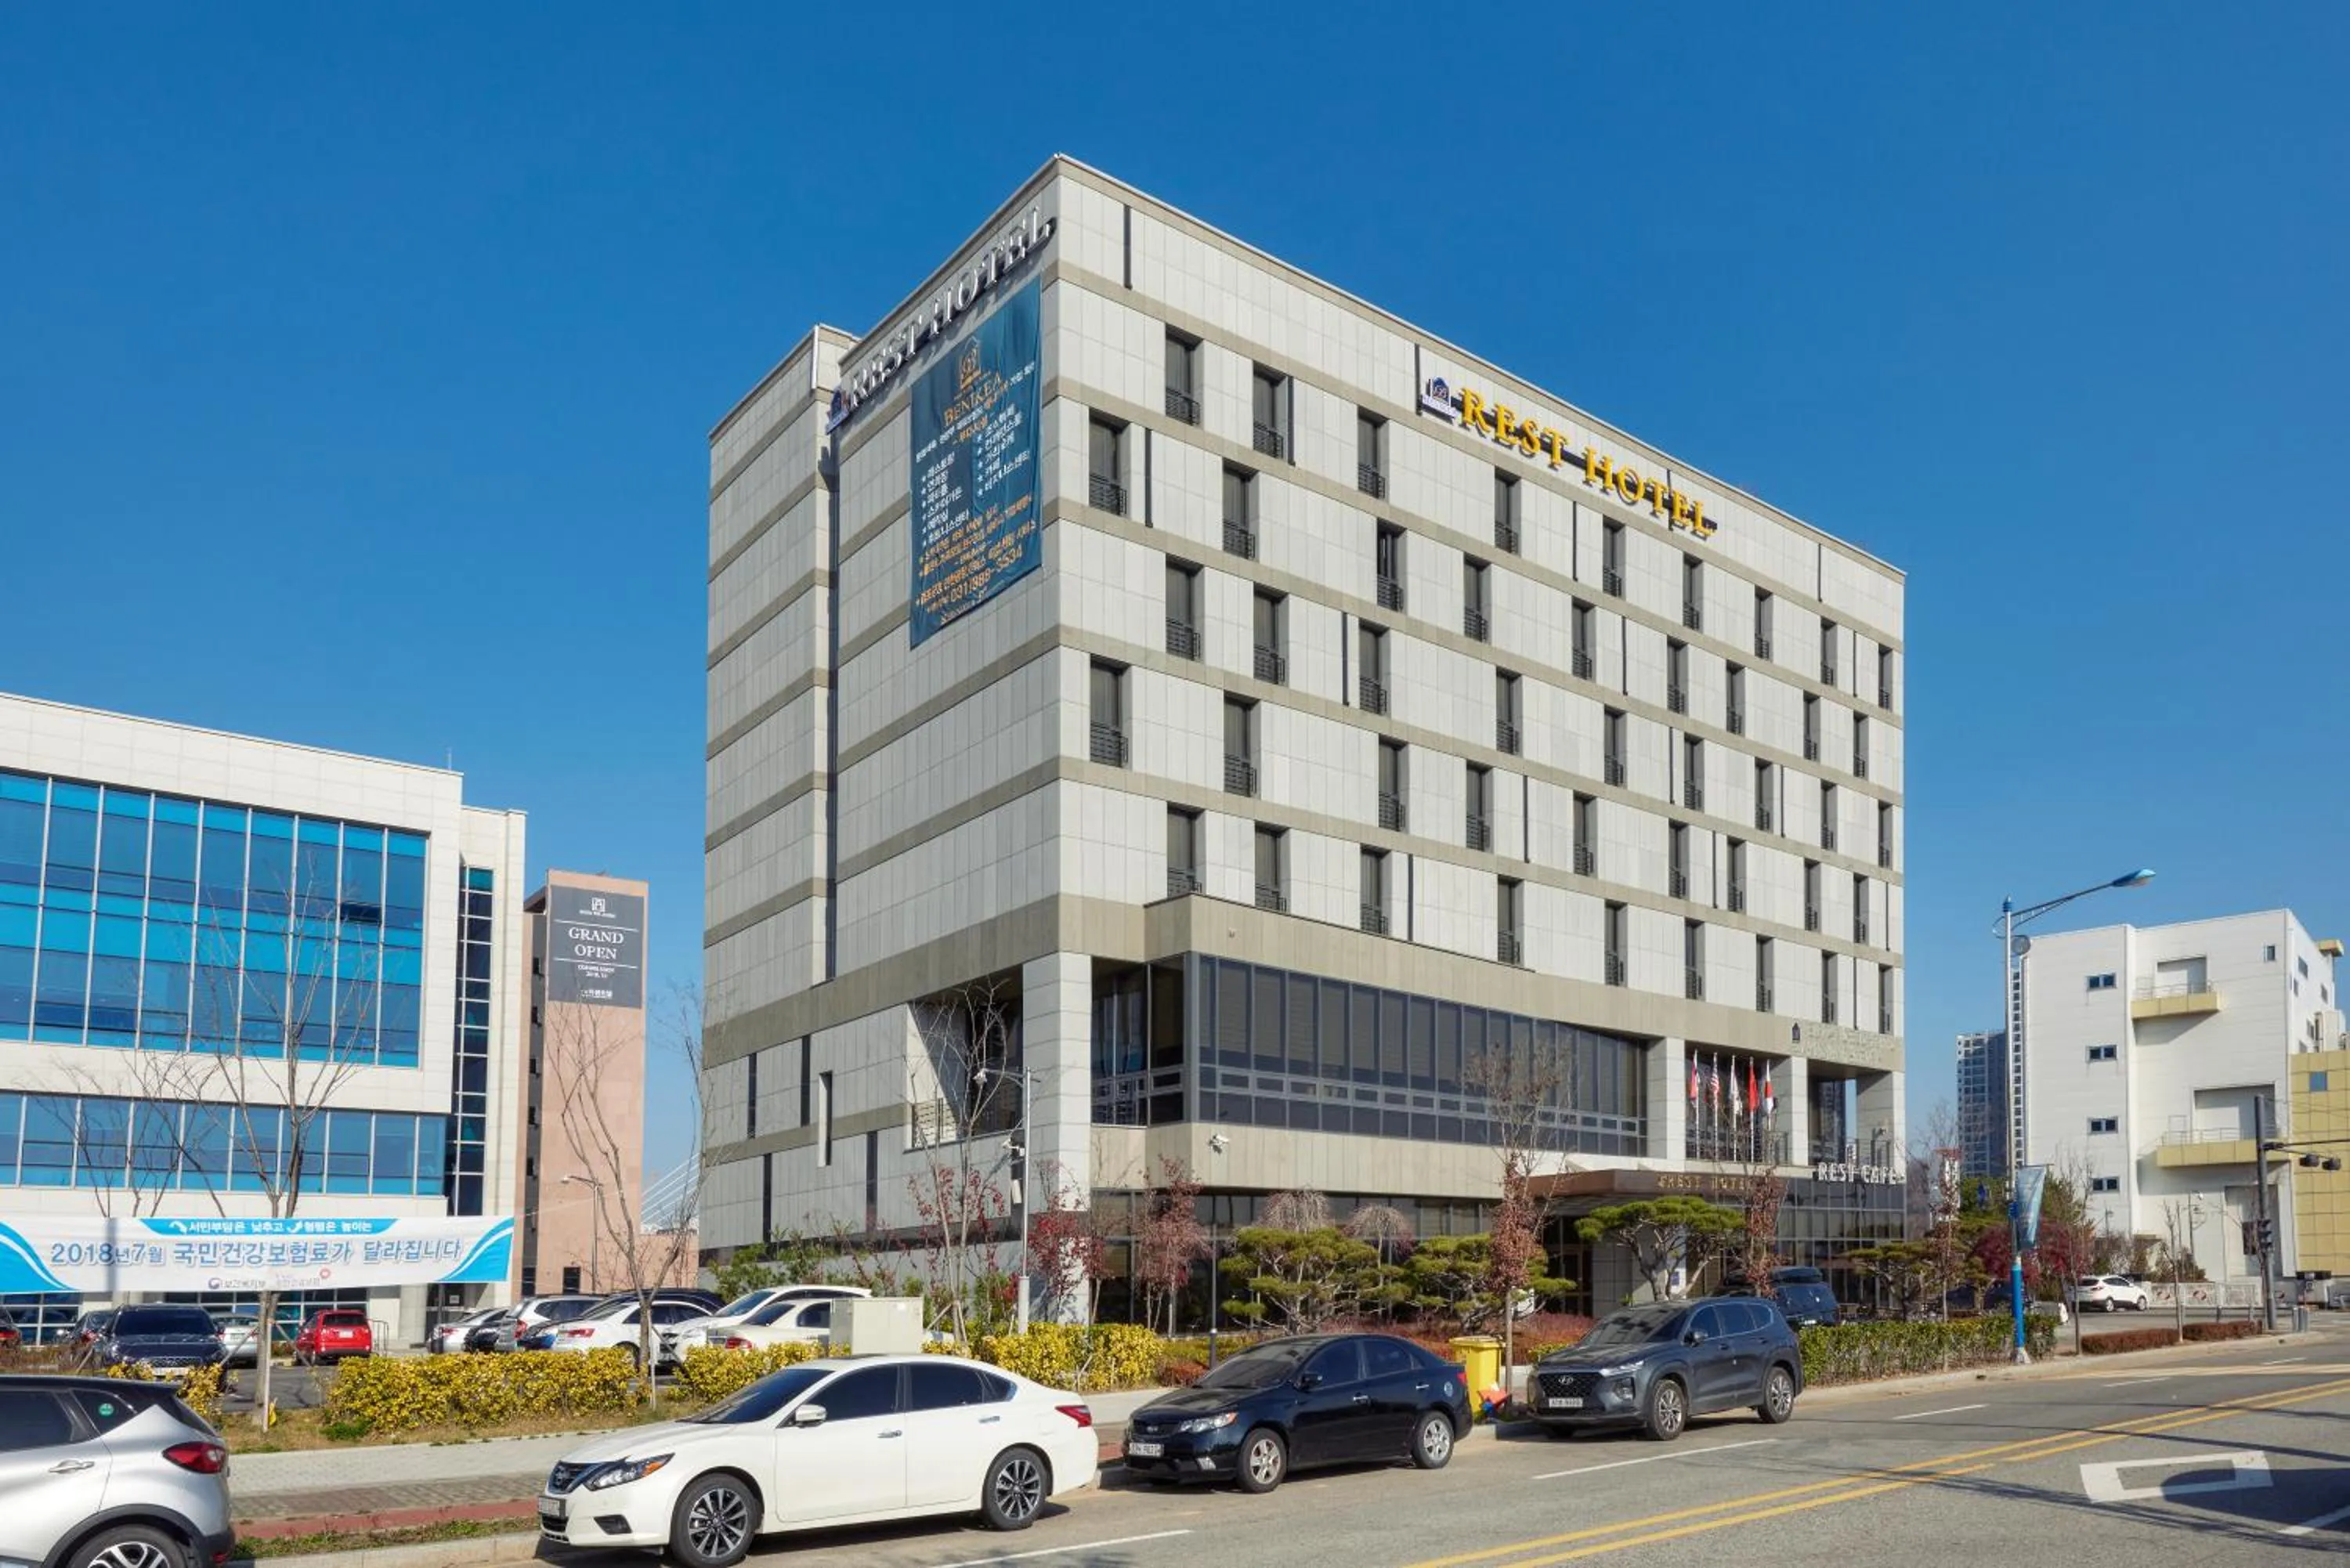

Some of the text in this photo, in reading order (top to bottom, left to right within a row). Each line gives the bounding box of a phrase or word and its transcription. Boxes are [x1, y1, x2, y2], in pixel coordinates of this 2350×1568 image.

[850, 206, 1056, 407] REST HOTEL
[1459, 387, 1716, 537] REST HOTEL
[568, 927, 624, 944] GRAND
[574, 944, 617, 959] OPEN
[51, 1237, 462, 1264] 2018년7월 국민건강보험료가 달라집니다
